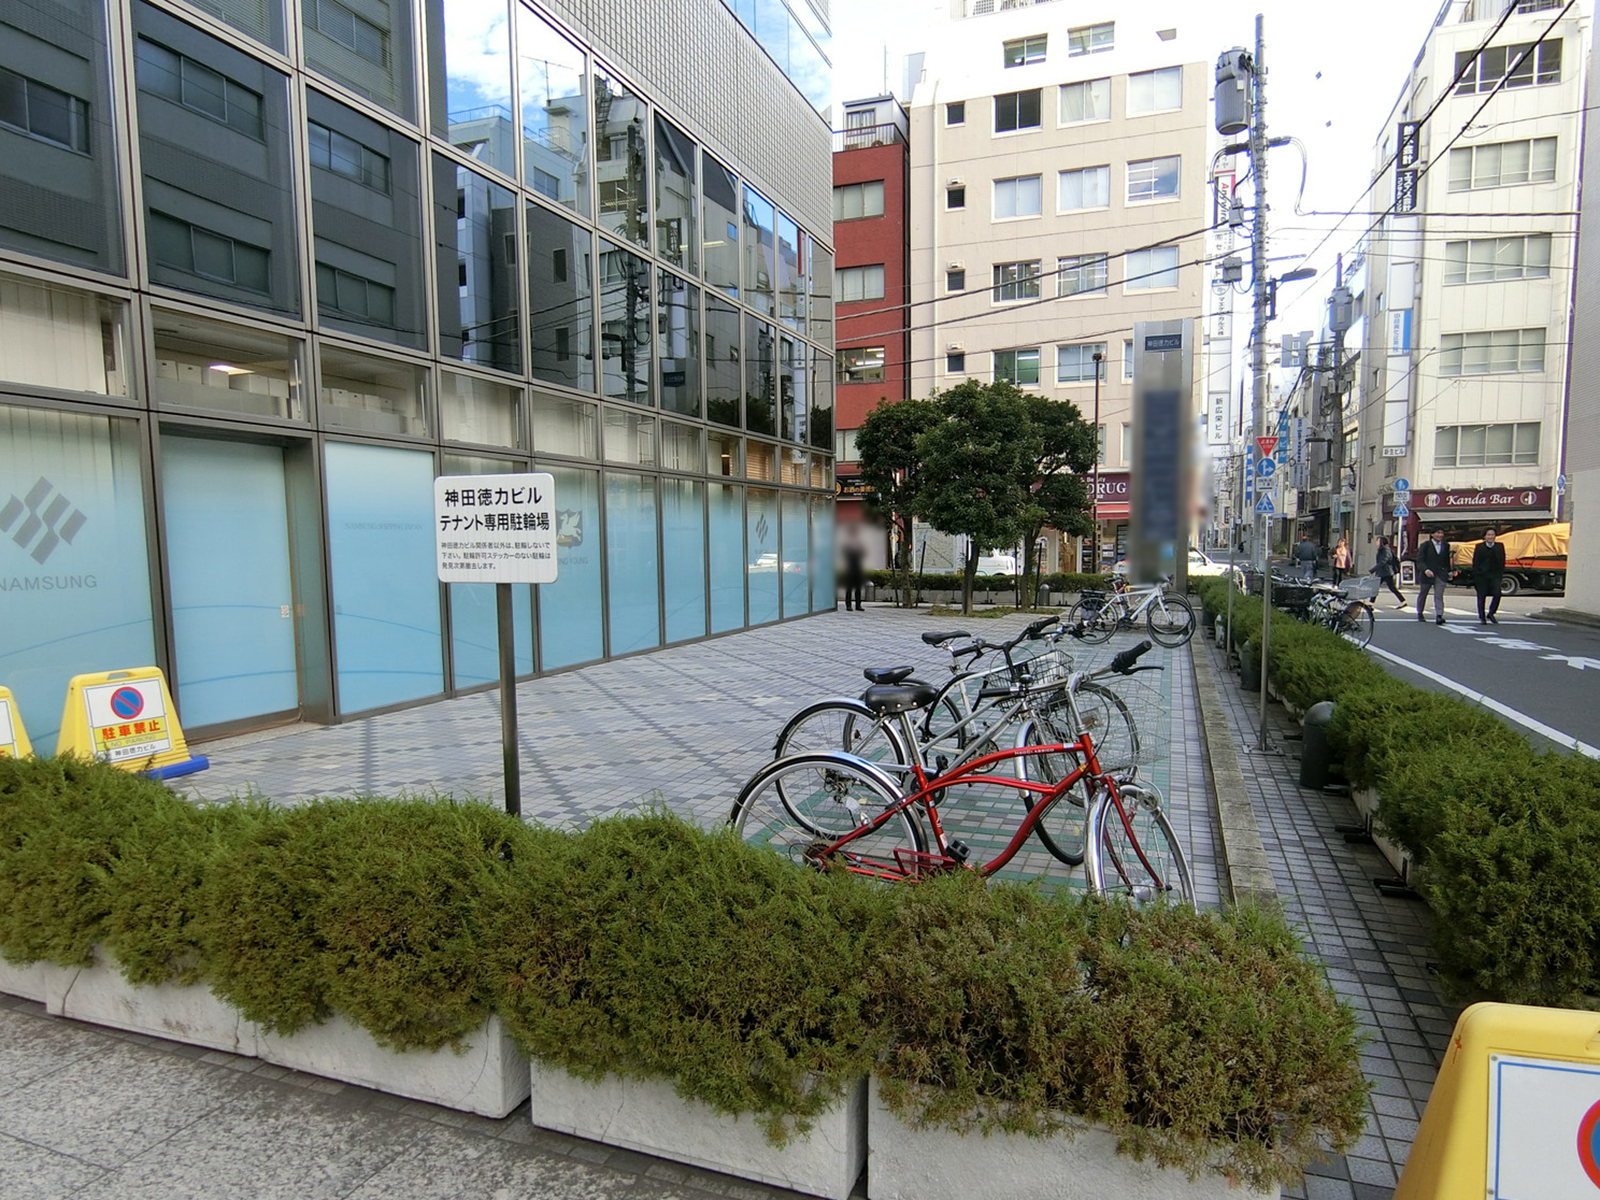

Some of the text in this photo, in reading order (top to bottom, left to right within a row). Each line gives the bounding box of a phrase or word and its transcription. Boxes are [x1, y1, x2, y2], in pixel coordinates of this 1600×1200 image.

[444, 487, 543, 508] 神田徳力ビル
[1446, 492, 1514, 505] Kanda Bar
[440, 512, 550, 532] テナント専用駐輪場
[441, 542, 551, 550] 神田徳力ビル関係者以外は、駐輪しないで
[0, 575, 98, 591] NAMSUNG
[102, 720, 161, 740] 駐車禁止
[115, 744, 156, 757] 神田徳力ビル
